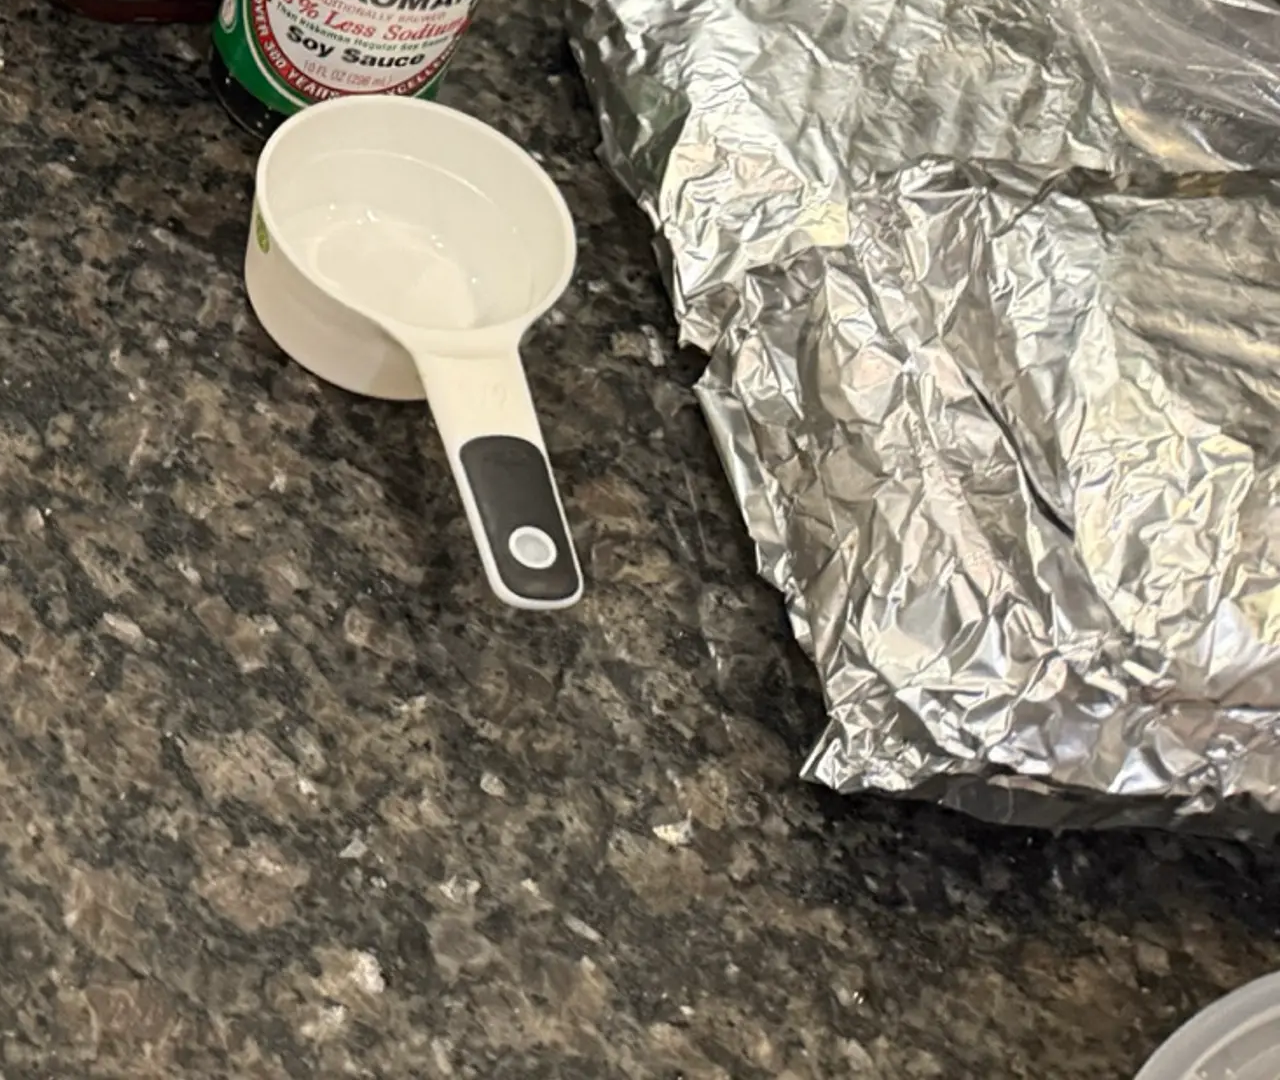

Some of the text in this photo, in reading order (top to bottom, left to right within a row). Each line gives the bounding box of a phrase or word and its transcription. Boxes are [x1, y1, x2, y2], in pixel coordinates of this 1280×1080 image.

[325, 10, 376, 38] Less
[382, 16, 472, 41] Sodium
[264, 40, 287, 68] 300
[285, 24, 426, 68] Soy Sauce
